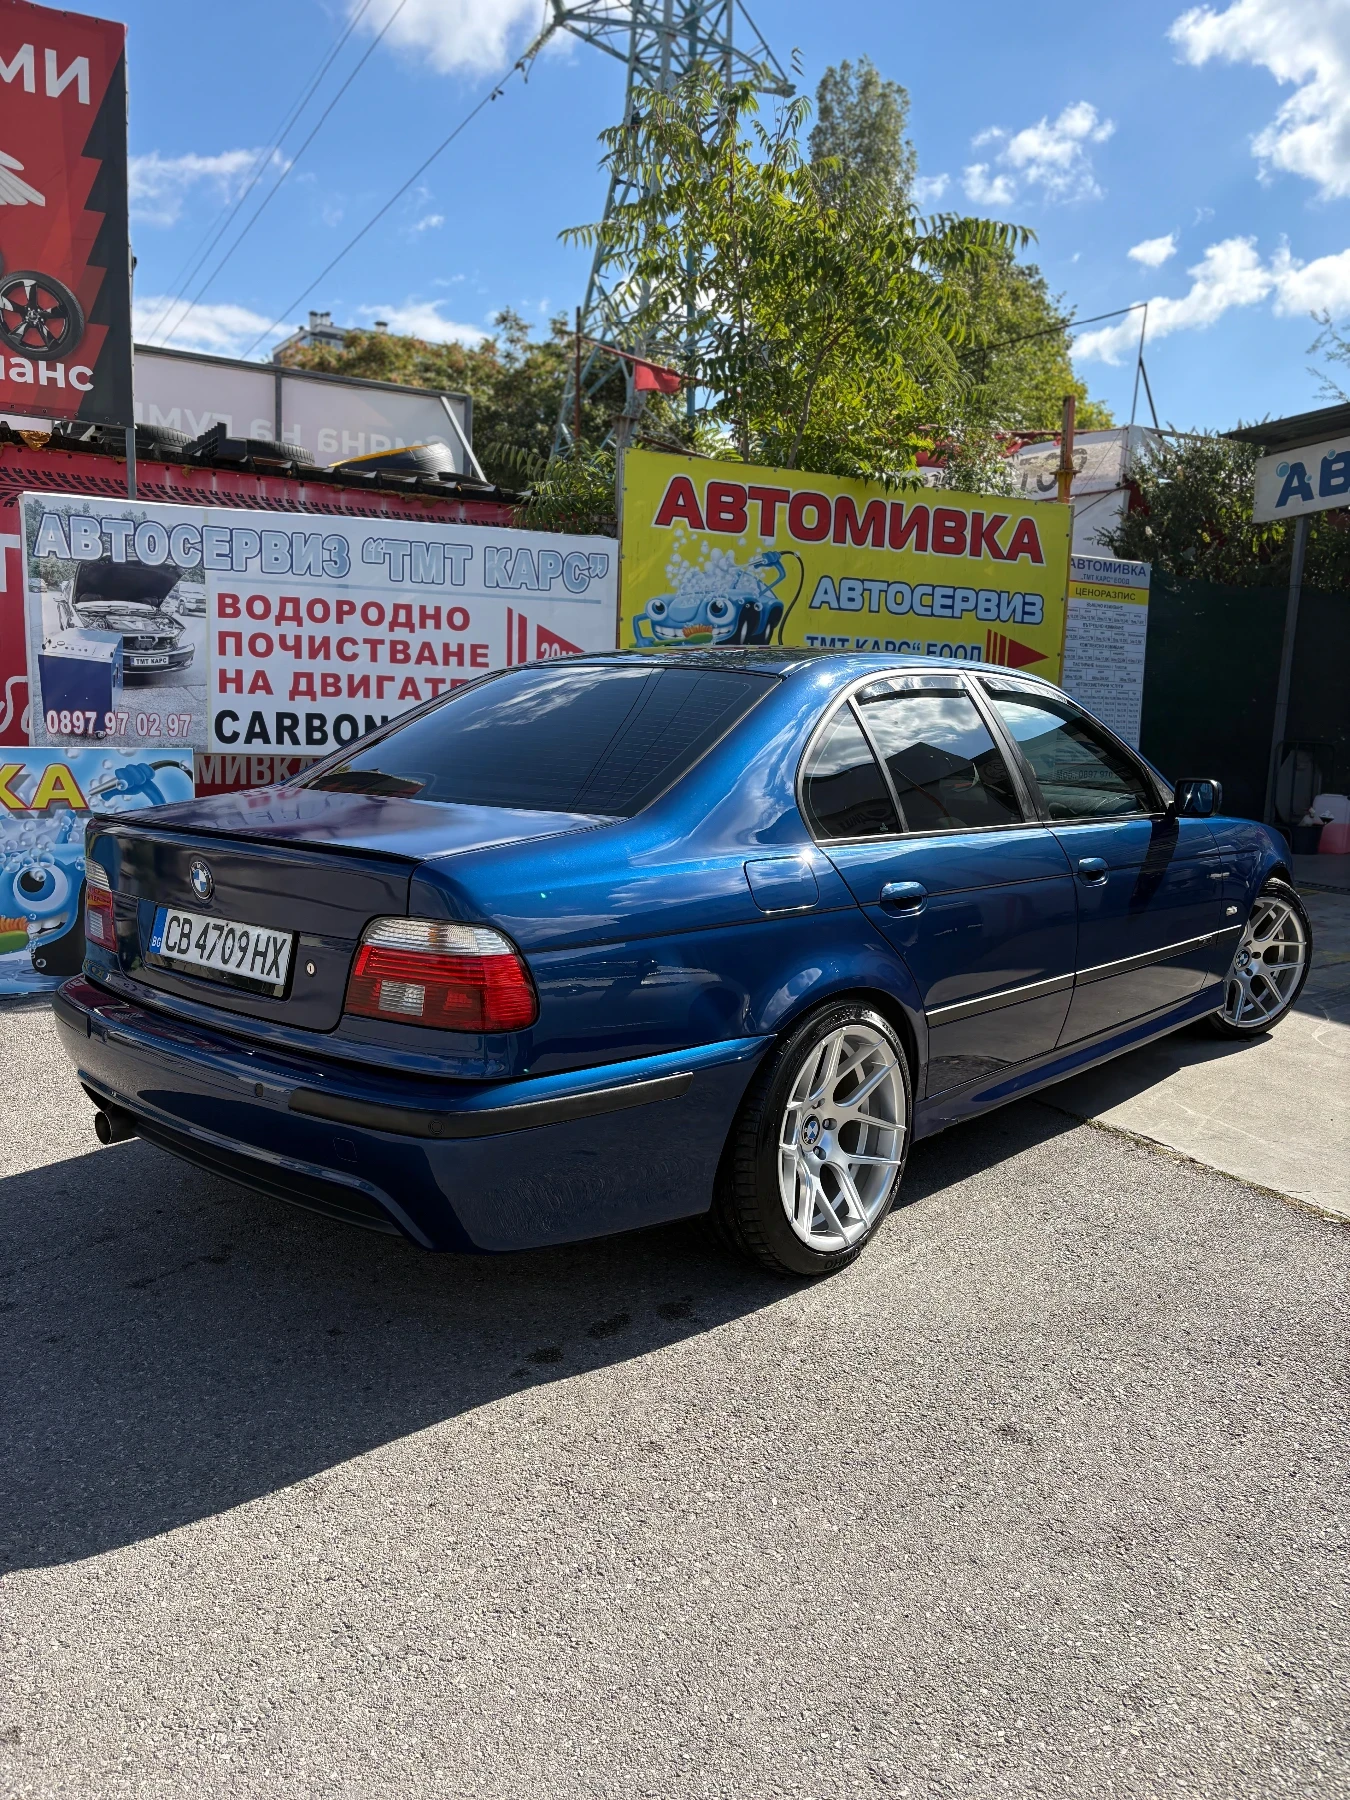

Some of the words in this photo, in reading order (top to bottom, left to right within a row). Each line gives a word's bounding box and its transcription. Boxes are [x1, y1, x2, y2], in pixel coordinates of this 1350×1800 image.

[652, 474, 1046, 566] АВТОМИВКА
[34, 513, 351, 579] АВТОСЕРВИЗ
[217, 592, 470, 633] ВОДОРОДНО
[809, 574, 1045, 626] АВТОСЕРВИЗ
[1075, 587, 1136, 600] ЦЕНОРАЗПИС
[217, 630, 490, 668] ПОЧИСТВАНЕ
[218, 668, 273, 696] НА
[46, 710, 97, 735] 0897
[104, 711, 129, 735] 97
[136, 713, 162, 737] 02
[167, 714, 192, 738] 97
[152, 936, 161, 948] BG
[165, 915, 192, 955] CB
[195, 921, 250, 969] 4709
[250, 934, 287, 979] HX
